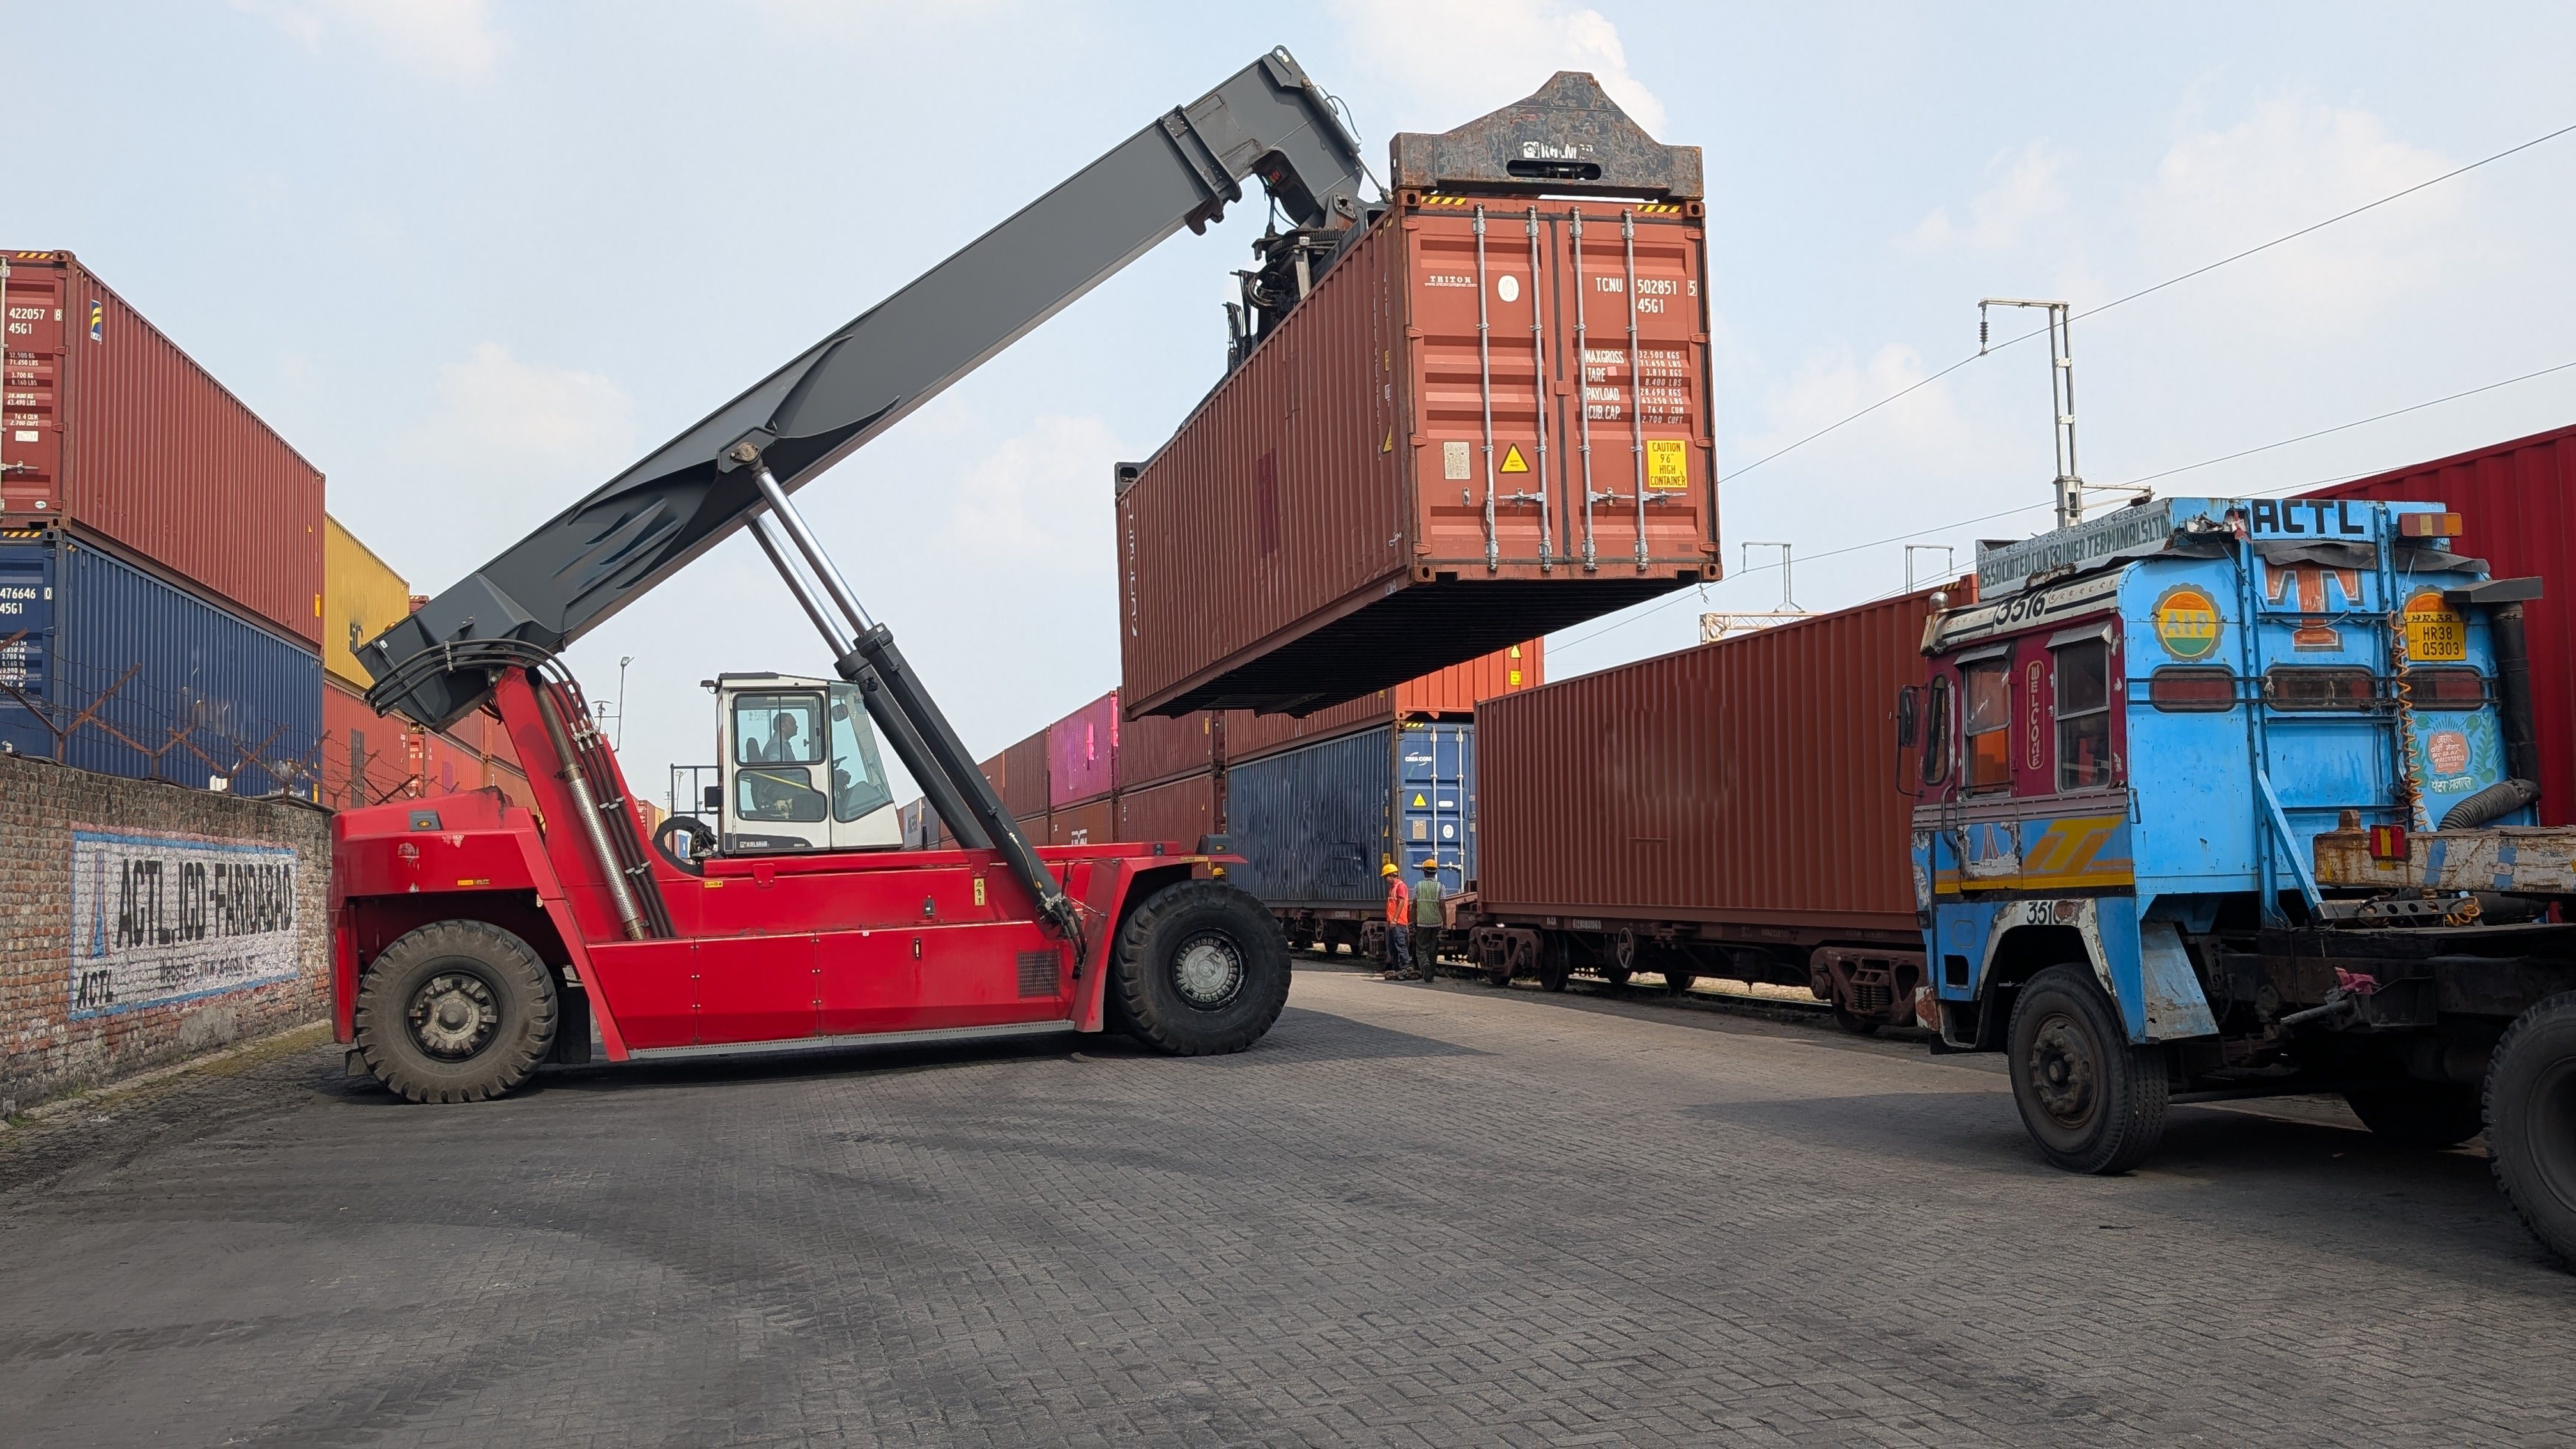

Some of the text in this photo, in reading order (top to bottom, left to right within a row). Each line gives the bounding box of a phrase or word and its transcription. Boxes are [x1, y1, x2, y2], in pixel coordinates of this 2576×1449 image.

[1595, 277, 1696, 296] TCNU 502851 5
[1637, 298, 1664, 313] 45G1
[9, 308, 61, 320] 422057 8
[8, 323, 32, 334] 45G1
[1584, 349, 1625, 364] MAXGROSS
[1639, 351, 1664, 359] 32.500
[1587, 367, 1606, 383] TARE
[1646, 368, 1666, 376] 3.810
[1586, 387, 1620, 401] PAYLOAD
[1640, 388, 1666, 396] 28.690
[1647, 406, 1663, 414] 76.4
[1641, 415, 1662, 424] 2.700
[1652, 442, 1681, 452] CAUTION
[1659, 464, 1676, 474] HIGH
[1650, 476, 1686, 486] CONTAINER
[2251, 499, 2365, 535] ACTL
[1979, 514, 2168, 590] ASSOCIATED CONTAINER TERMINALS LTD
[0, 587, 52, 599] 476646 0
[0, 602, 22, 614] 45G1
[2164, 611, 2209, 635] AIP
[2423, 626, 2453, 640] HR38
[2030, 664, 2041, 766] WELCOME
[76, 969, 114, 1008] ACTL
